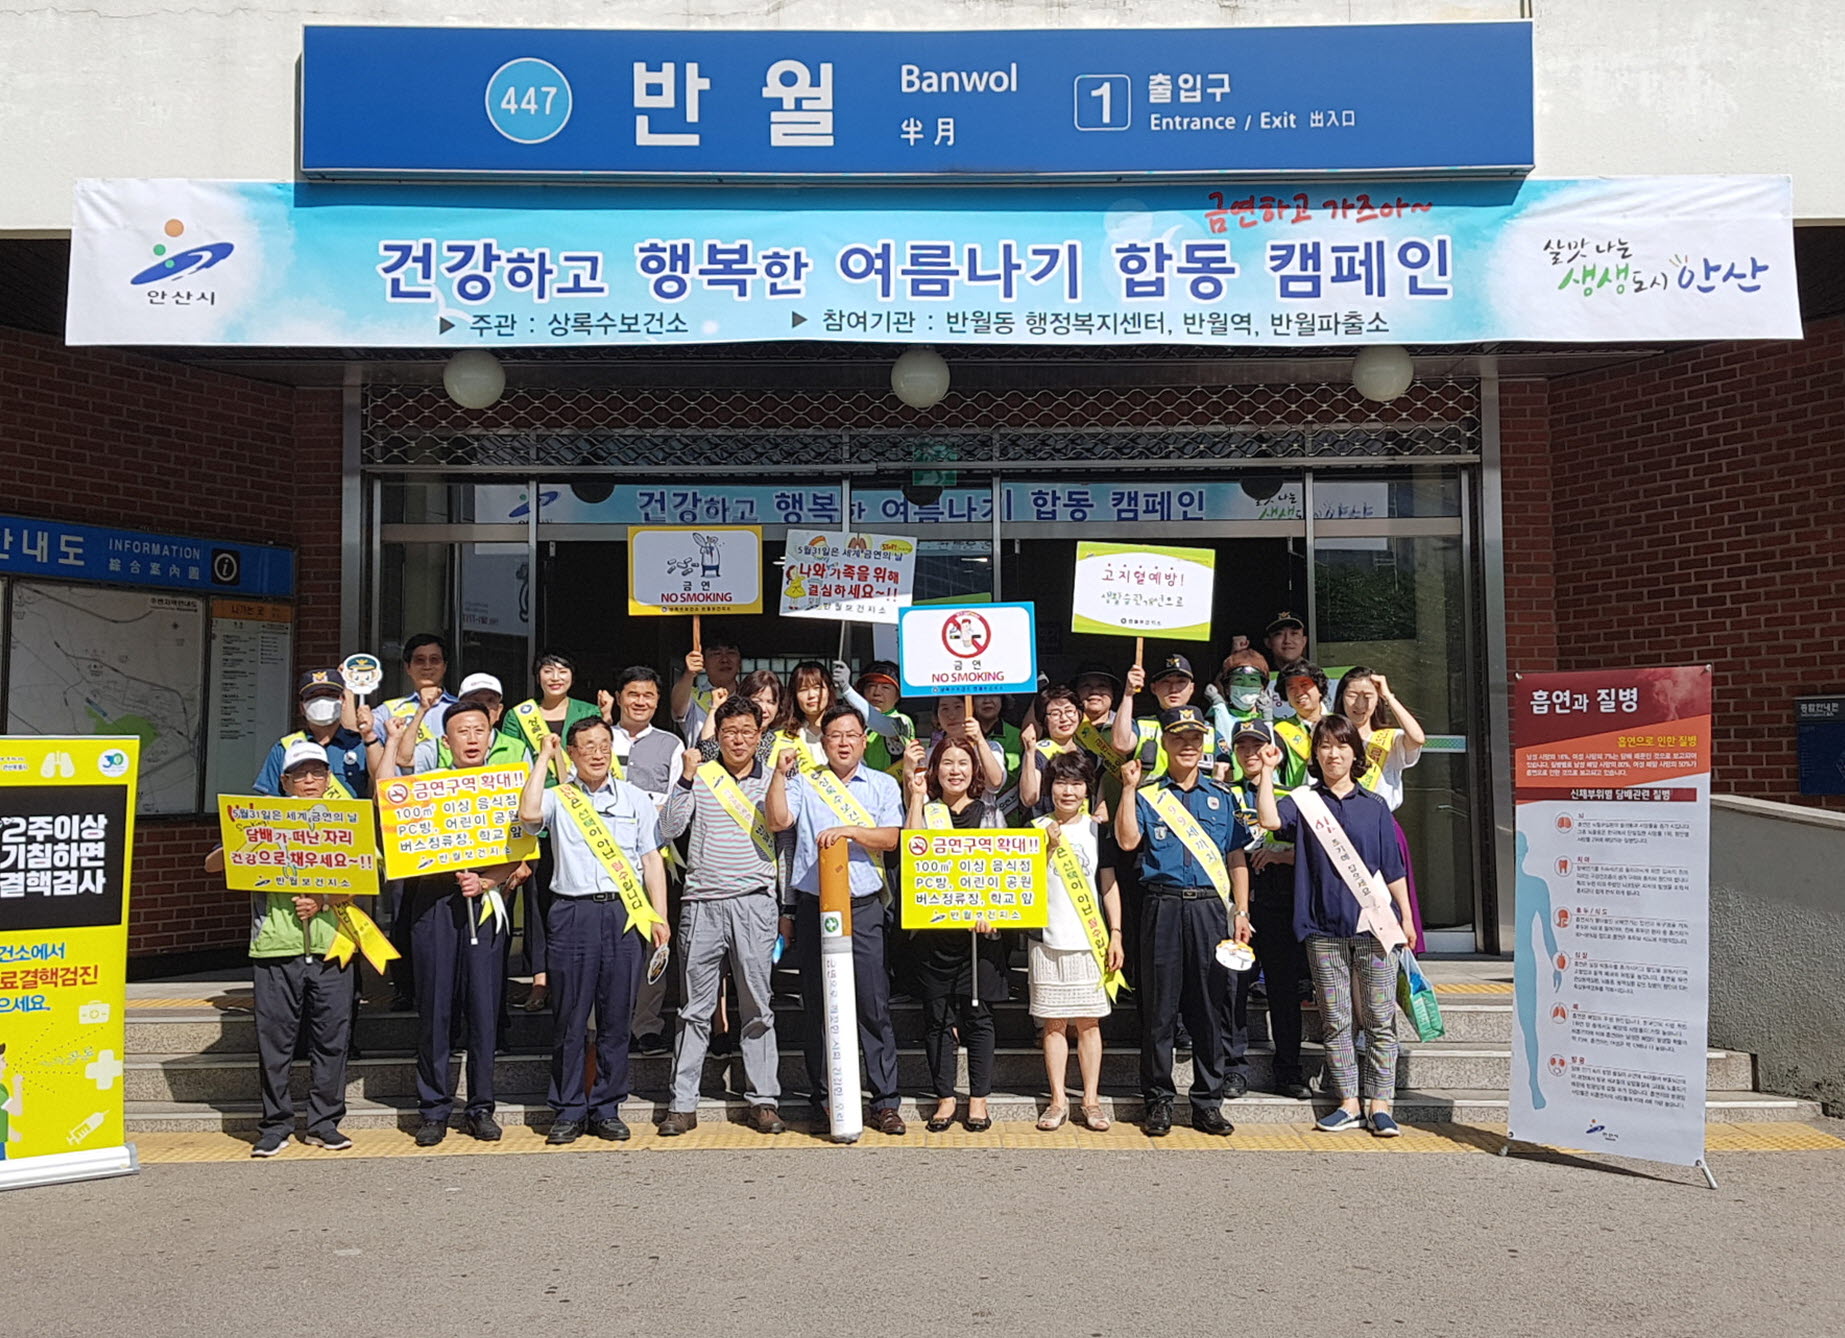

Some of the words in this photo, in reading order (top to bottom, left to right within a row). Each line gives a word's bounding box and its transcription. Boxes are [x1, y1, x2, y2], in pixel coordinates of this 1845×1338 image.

[900, 62, 1018, 93] Banwol
[1148, 72, 1231, 103] 출입구
[501, 85, 558, 115] 447
[1090, 82, 1114, 123] 1
[1150, 112, 1236, 131] Entrance
[1260, 111, 1297, 129] Exit
[1309, 109, 1356, 128] 出入口
[900, 117, 957, 147] 半月
[1204, 191, 1313, 234] 금연하고
[1322, 195, 1434, 223] 가즈아~
[1543, 238, 1588, 265] 살맛
[1596, 238, 1633, 259] 나는
[378, 240, 609, 301] 건강하고
[637, 240, 810, 300] 행복한
[838, 240, 1081, 301] 여름나기
[1114, 239, 1237, 301] 합동
[1267, 236, 1453, 300] 캠페인
[1558, 262, 1669, 297] 생생도시
[1677, 257, 1770, 293] 안산
[147, 290, 216, 306] 안산시
[470, 313, 517, 336] 주관
[548, 310, 690, 336] 상록수보건소
[822, 309, 916, 335] 참여기관
[946, 312, 1016, 335] 반월동
[1026, 311, 1174, 337] 행정복지센터,
[1182, 311, 1260, 337] 반월역,
[1270, 311, 1390, 336] 반월파출소
[1030, 489, 1095, 521] 합동
[1111, 489, 1205, 521] 캠페인
[109, 538, 201, 560] INFORMATION
[798, 545, 839, 557] 5월31일은
[800, 562, 826, 579] 나와
[830, 564, 870, 582] 가족을
[874, 567, 900, 584] 위해
[661, 593, 679, 603] NO
[680, 592, 732, 603] SMOKING
[932, 673, 949, 683] NO
[952, 671, 1004, 682] SMOKING
[1530, 690, 1589, 714] 흡연과
[1597, 687, 1638, 713] 질병
[1617, 736, 1655, 748] 흡연으로
[1657, 736, 1676, 747] 인한
[1679, 735, 1698, 747] 질병
[413, 777, 476, 799] 금연구역
[481, 772, 524, 790] 확대!!
[444, 801, 470, 813] 이상
[478, 795, 517, 810] 음식점
[232, 808, 282, 820] 5월31일은
[286, 812, 307, 822] 세계
[311, 811, 344, 823] 금연의
[347, 813, 358, 823] 날
[445, 815, 487, 830] 어린이
[494, 810, 520, 824] 공원
[246, 827, 288, 844] 담배가
[292, 830, 320, 845] 떠난
[324, 830, 352, 846] 자리
[399, 833, 473, 852] 버스정류장,
[479, 829, 504, 841] 학교
[510, 826, 522, 839] 앞
[933, 838, 992, 854] 금연구역
[997, 837, 1039, 854] 확대!!
[0, 842, 105, 869] 기침하면
[231, 850, 287, 866] 건강으로
[290, 851, 372, 869] 채우세요~!!
[959, 860, 984, 873] 이상
[993, 860, 1031, 872] 음식점
[0, 869, 106, 898] 결핵검사
[960, 877, 999, 889] 어린이
[1006, 876, 1032, 888] 공원
[916, 893, 984, 905] 버스정류장,
[991, 893, 1015, 905] 학교
[1021, 892, 1033, 905] 앞
